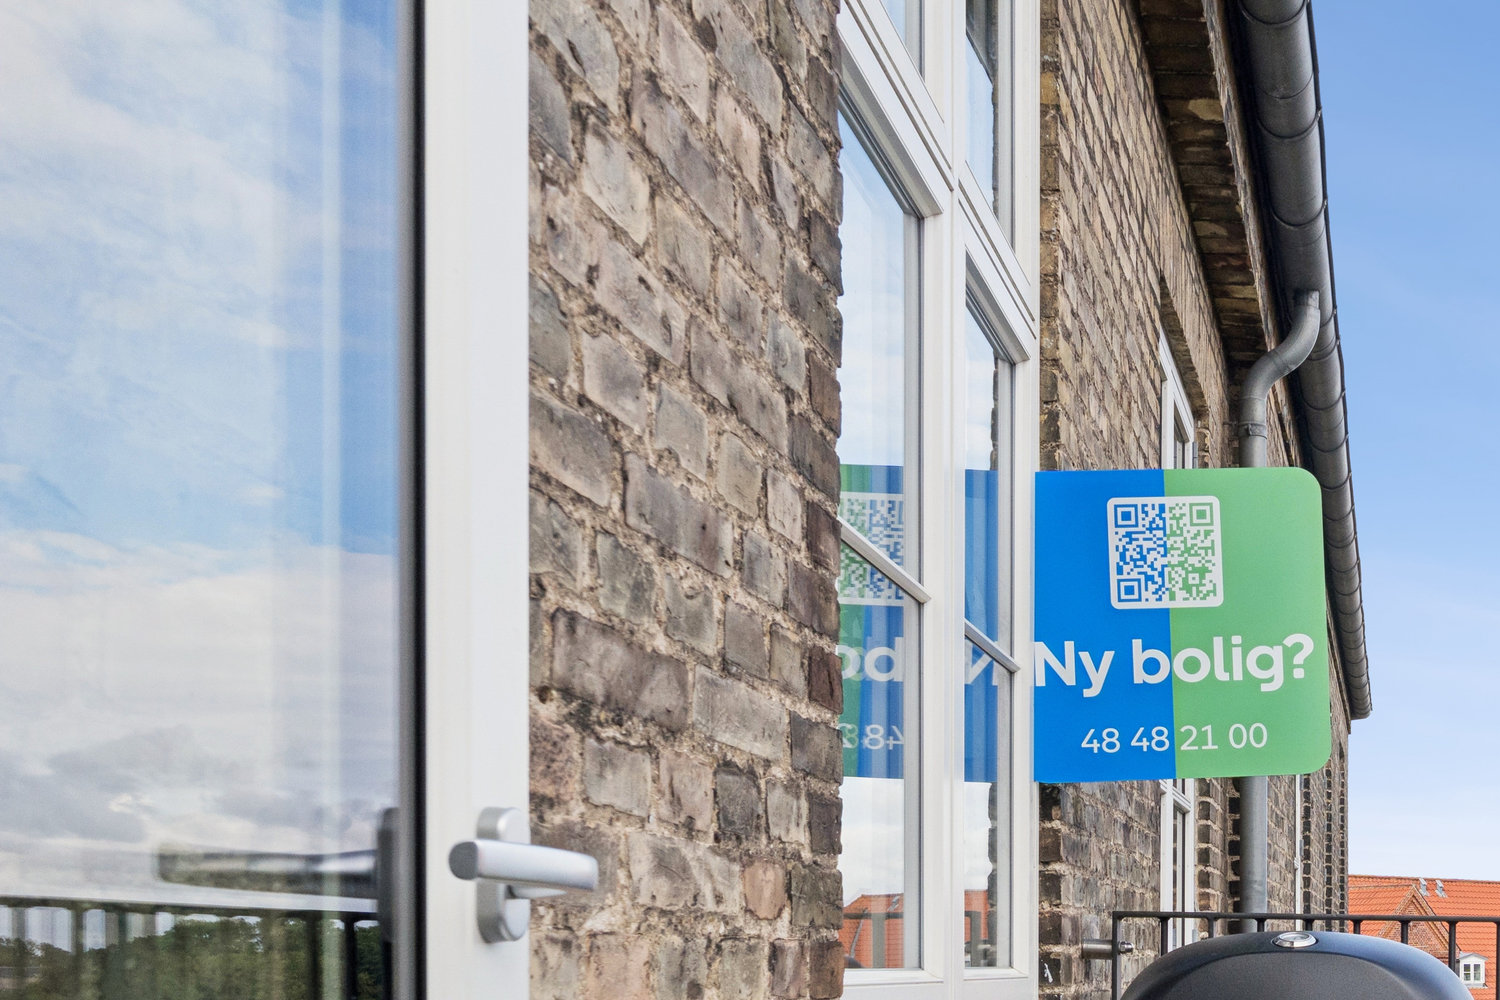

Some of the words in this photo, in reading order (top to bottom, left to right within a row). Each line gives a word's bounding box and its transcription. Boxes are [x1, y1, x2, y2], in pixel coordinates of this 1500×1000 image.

[1034, 641, 1115, 698] Ny
[1132, 633, 1314, 692] bolig?
[1081, 728, 1121, 753] 48
[1131, 726, 1170, 752] 48
[1180, 725, 1218, 750] 21
[1228, 722, 1268, 749] 00
